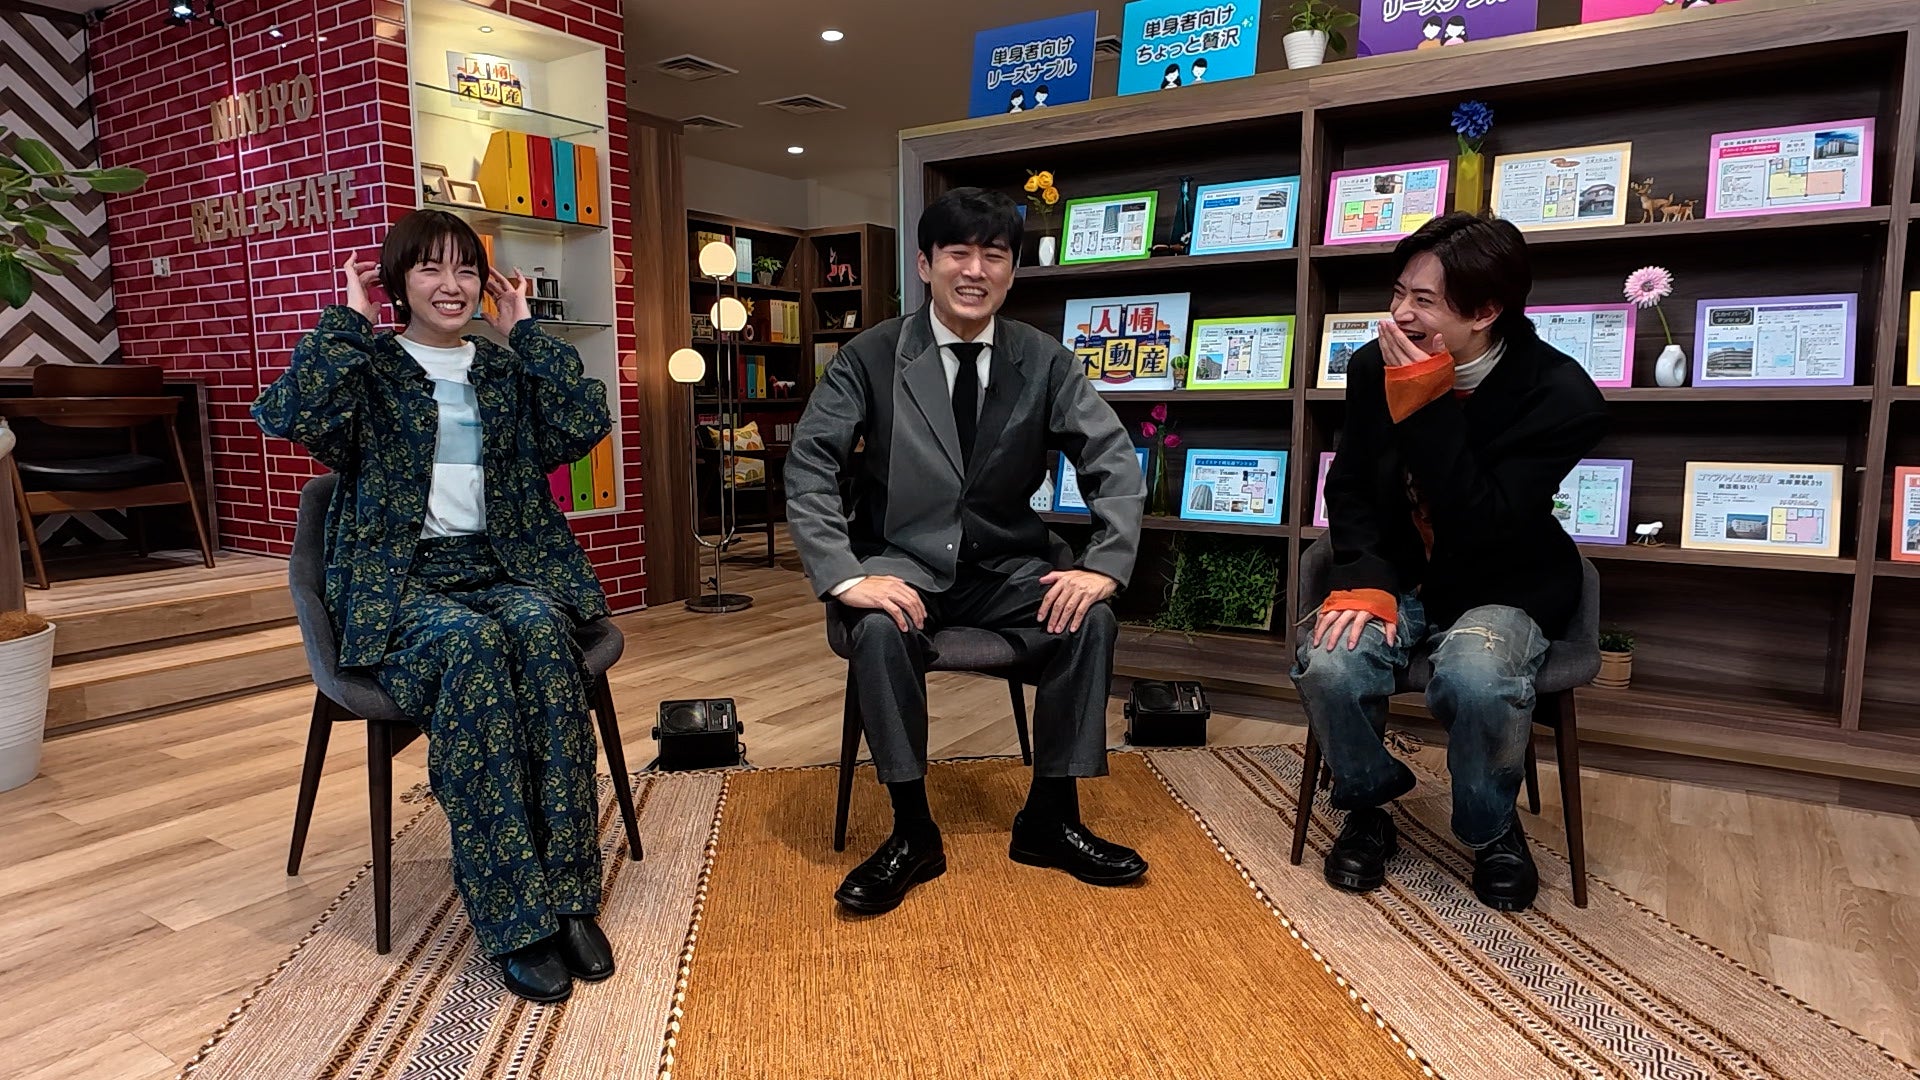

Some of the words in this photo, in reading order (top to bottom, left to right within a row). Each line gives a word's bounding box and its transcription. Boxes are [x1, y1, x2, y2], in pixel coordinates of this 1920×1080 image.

[1145, 4, 1235, 40] 単身者向け
[992, 36, 1075, 66] 単身者向け
[1136, 27, 1240, 65] ちょっと贅沢
[469, 62, 508, 79] 人情
[986, 58, 1077, 89] リーズナブル
[211, 73, 314, 144] NINJYO
[460, 83, 519, 105] 不動産
[191, 192, 254, 244] REAL
[255, 170, 359, 233] ESTATE
[1092, 307, 1156, 335] 人情
[1077, 342, 1165, 376] 不動産
